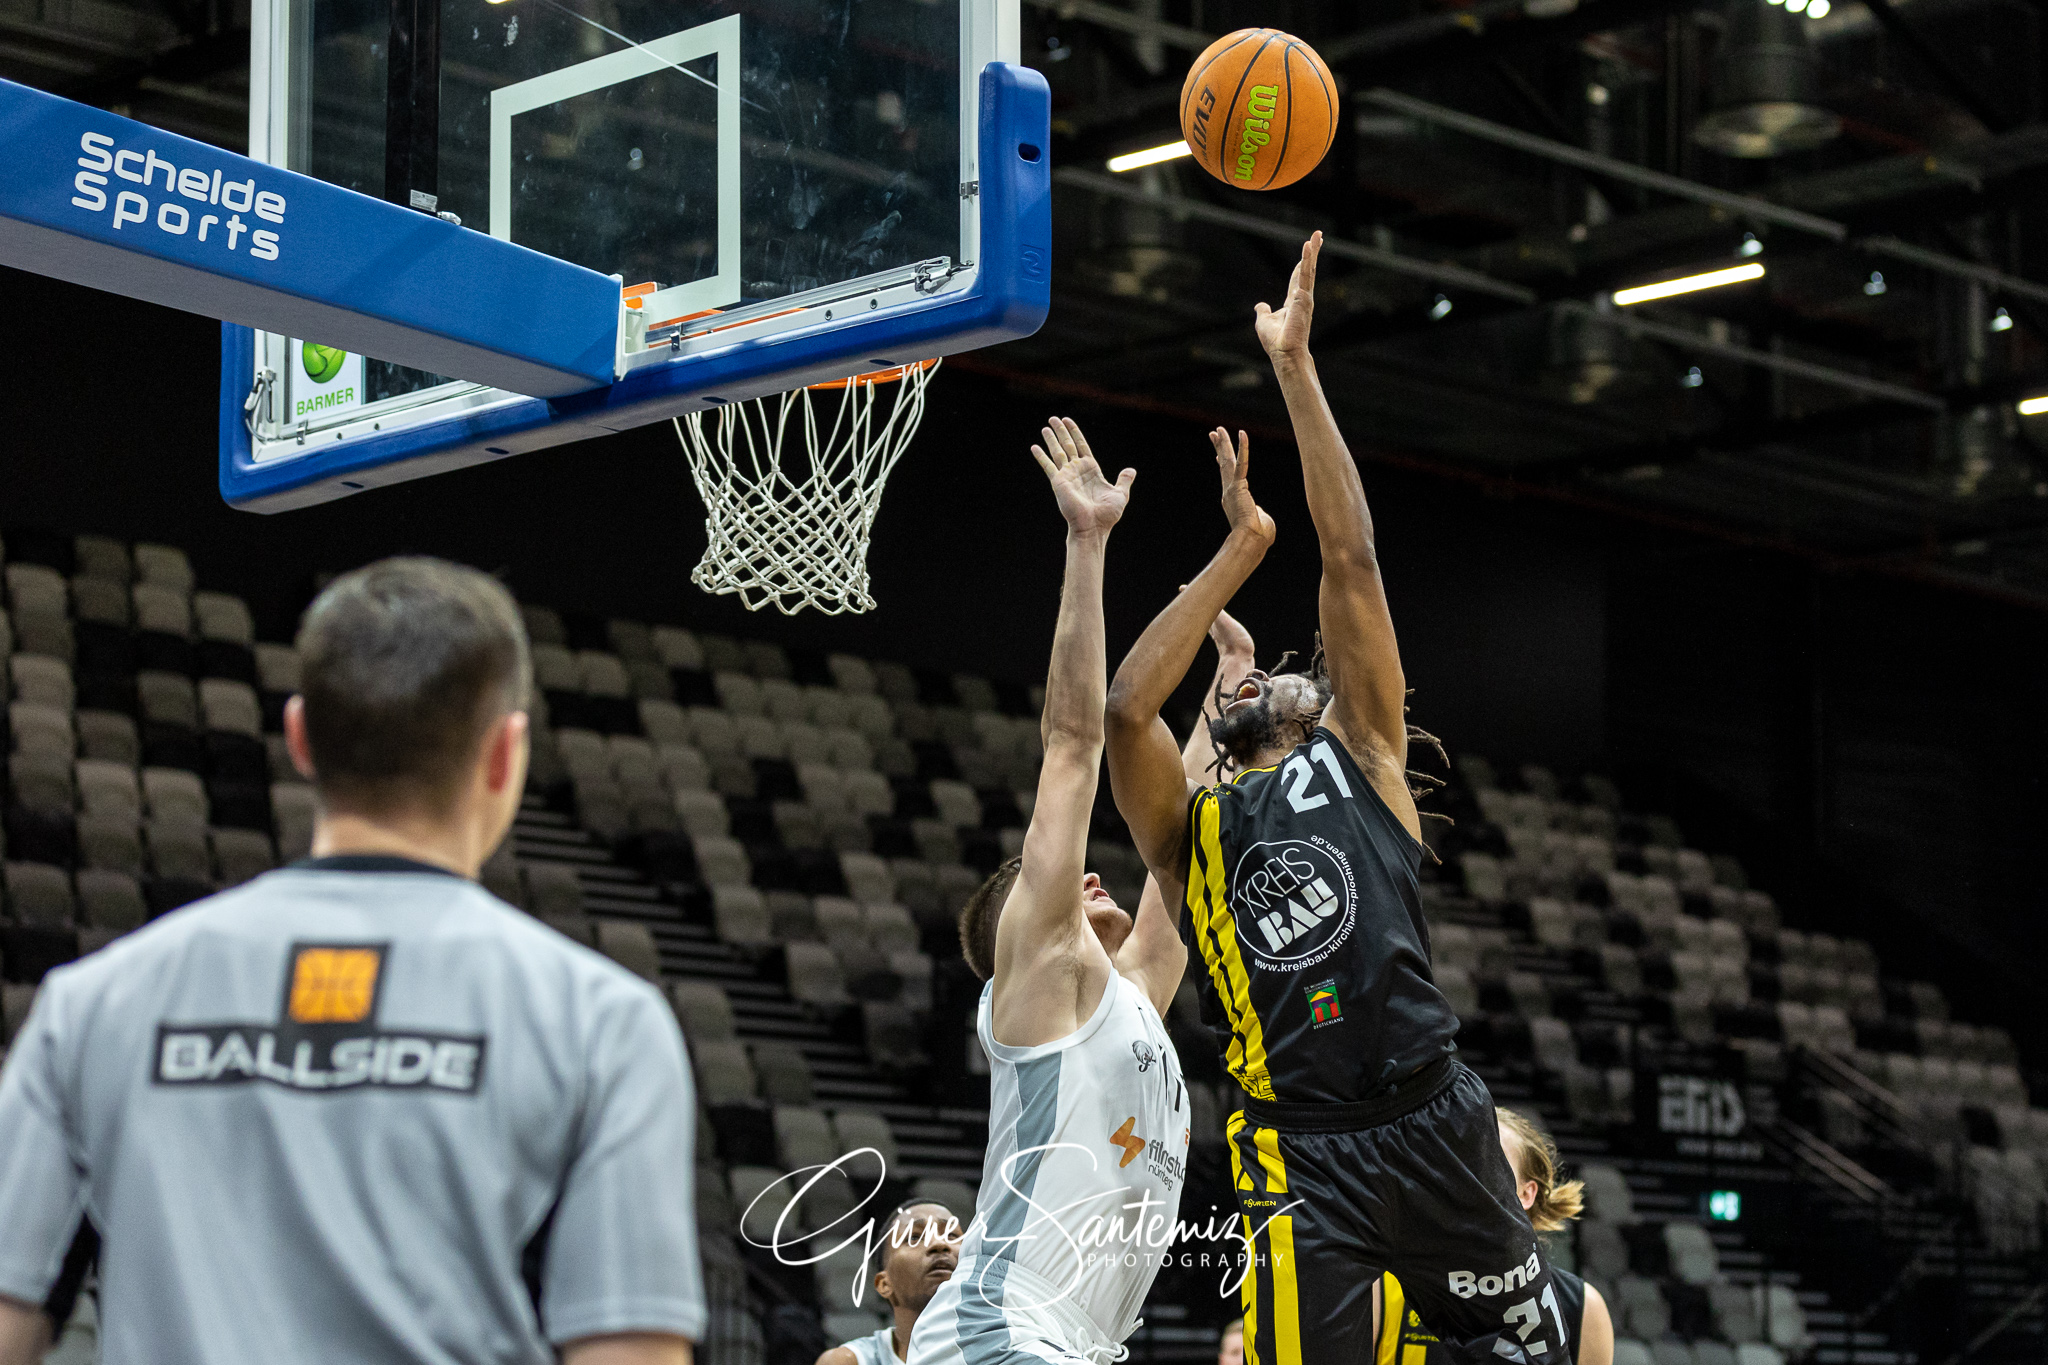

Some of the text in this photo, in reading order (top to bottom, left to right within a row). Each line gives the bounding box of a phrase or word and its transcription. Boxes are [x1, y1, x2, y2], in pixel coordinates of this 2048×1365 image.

[1234, 84, 1279, 181] Wilson
[71, 171, 280, 261] Sports
[77, 131, 287, 224] Schelde
[296, 387, 354, 416] BARMER
[1281, 740, 1354, 814] 21
[1238, 847, 1315, 918] KREIS
[1254, 834, 1359, 972] www.kreisbau-kirchheim-plochingen.de
[1257, 876, 1339, 954] BAU
[160, 1032, 481, 1092] BALLSIDE
[1447, 1251, 1541, 1299] Bona
[1492, 1282, 1567, 1365] 21
